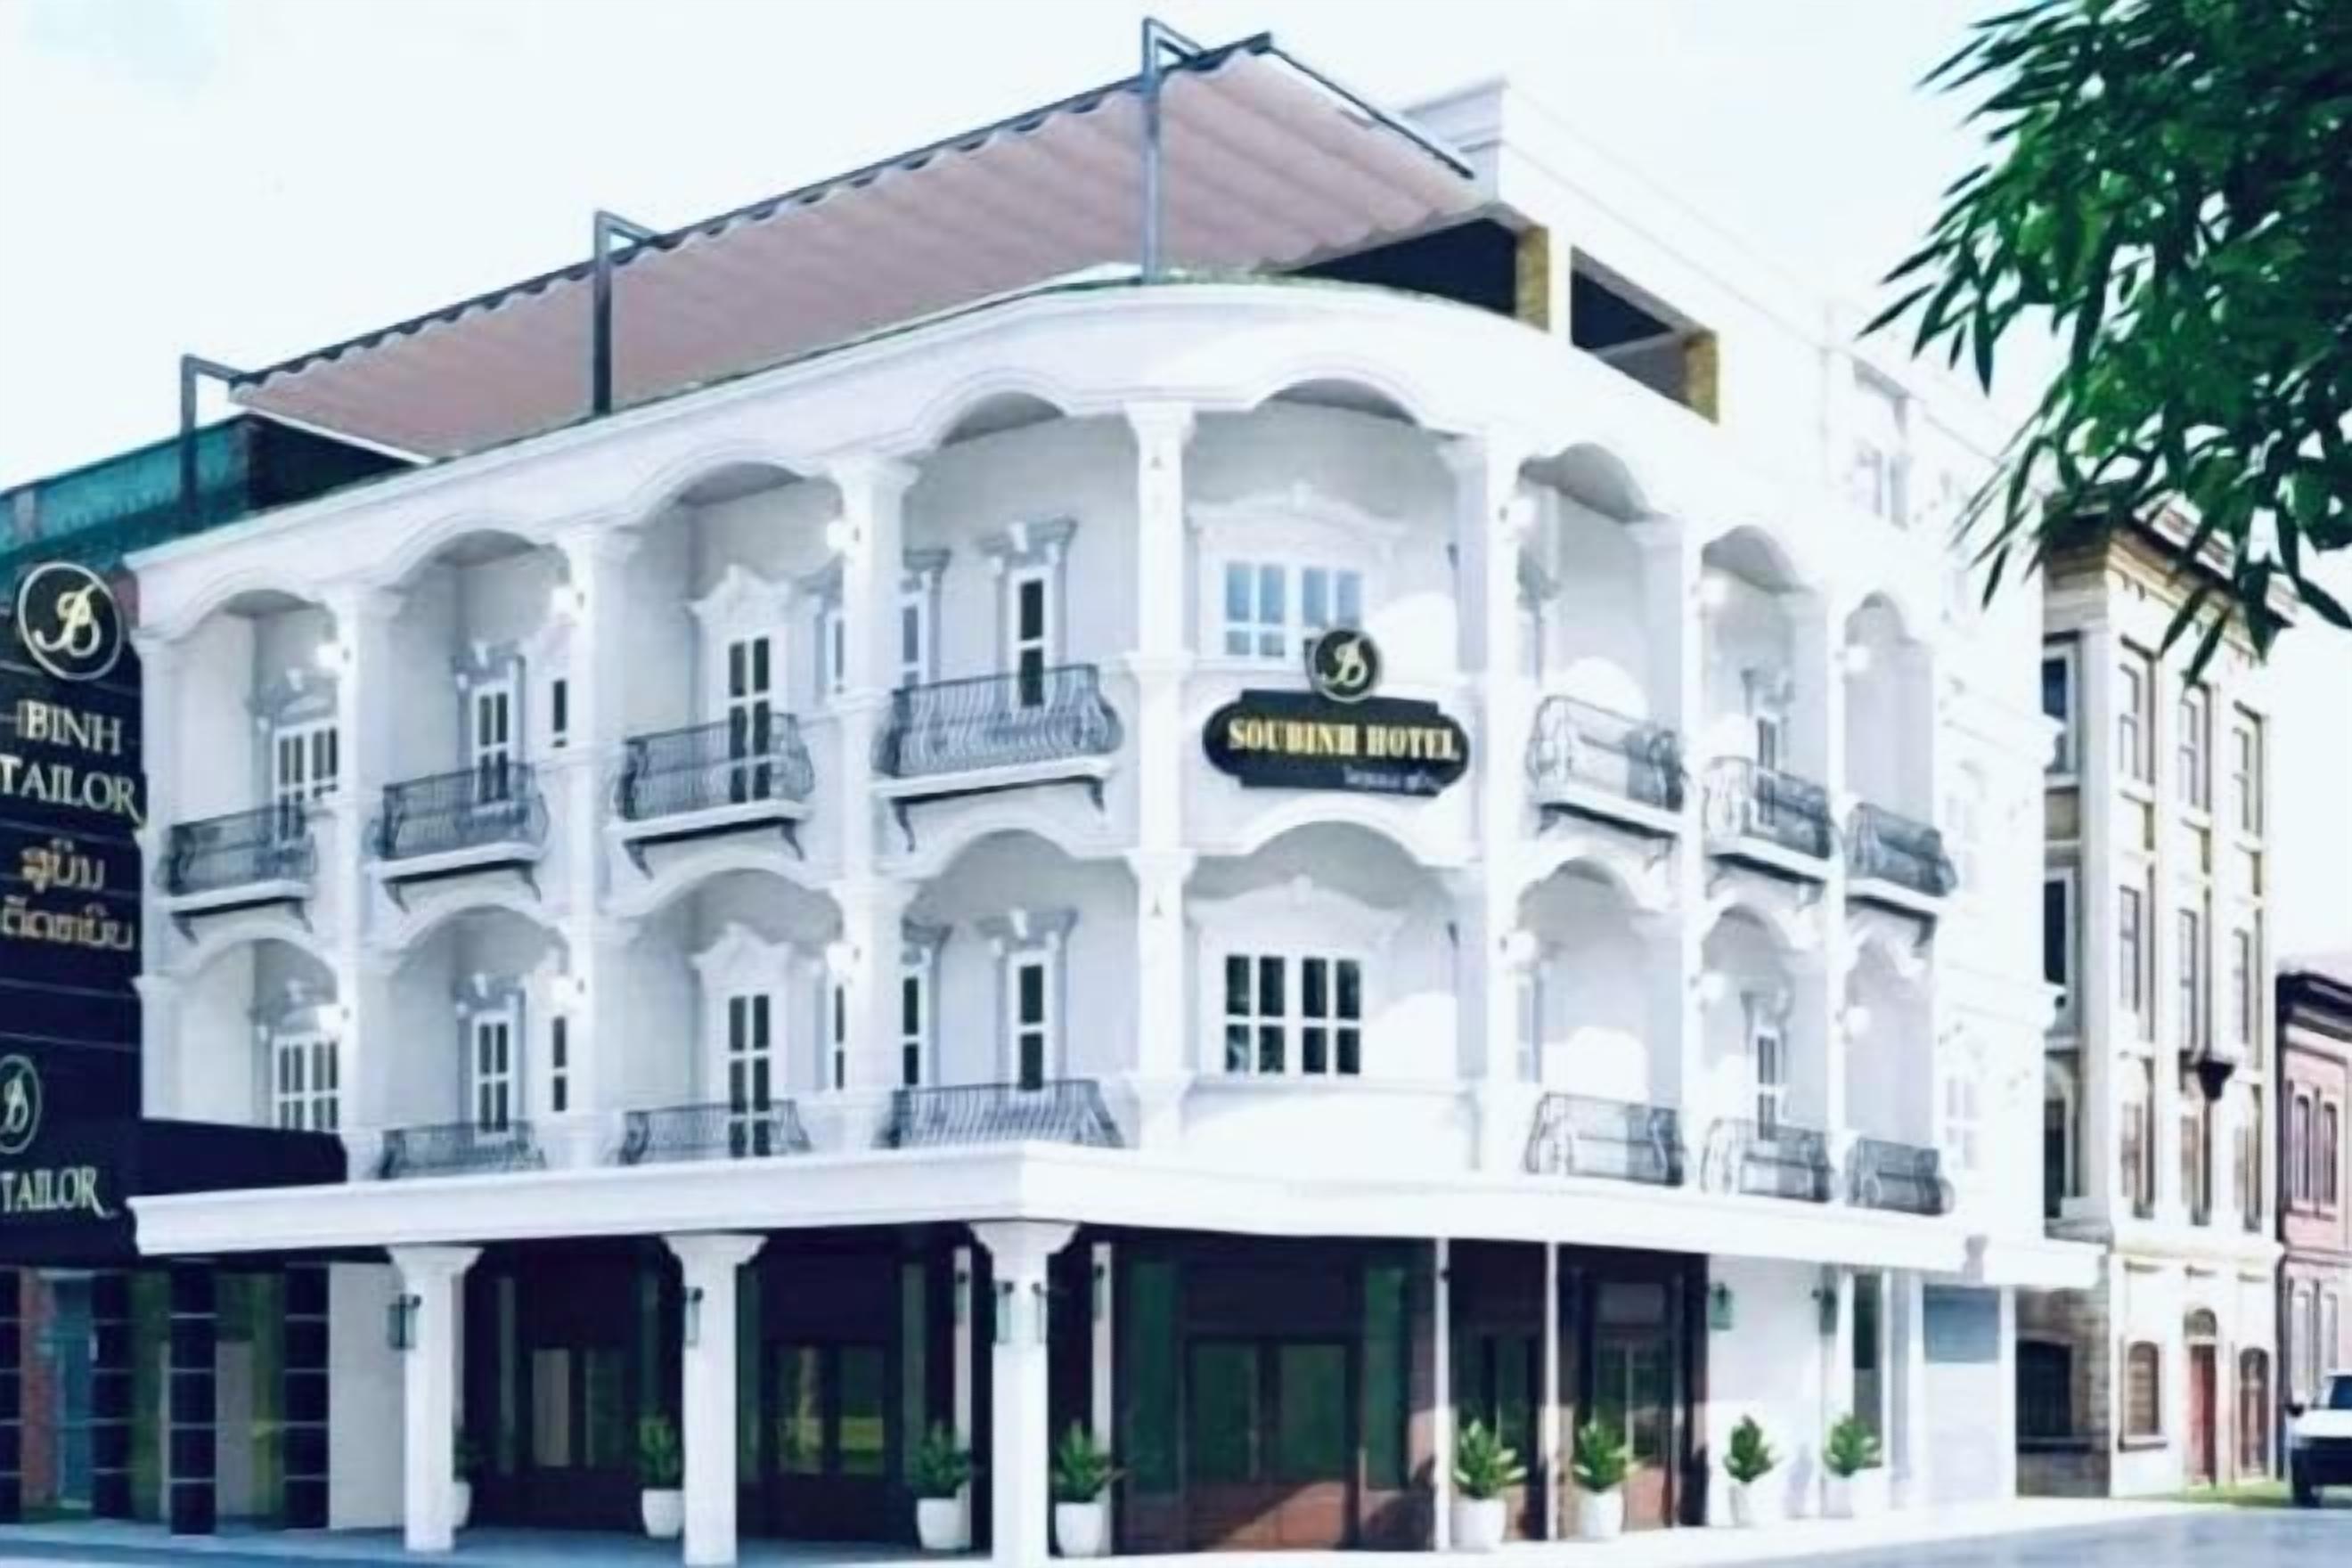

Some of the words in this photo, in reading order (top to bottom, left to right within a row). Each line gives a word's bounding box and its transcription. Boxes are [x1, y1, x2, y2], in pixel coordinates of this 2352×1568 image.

[1366, 723, 1460, 761] HOTEL
[0, 755, 146, 829] TAILOR
[0, 1164, 119, 1219] TAILOR
